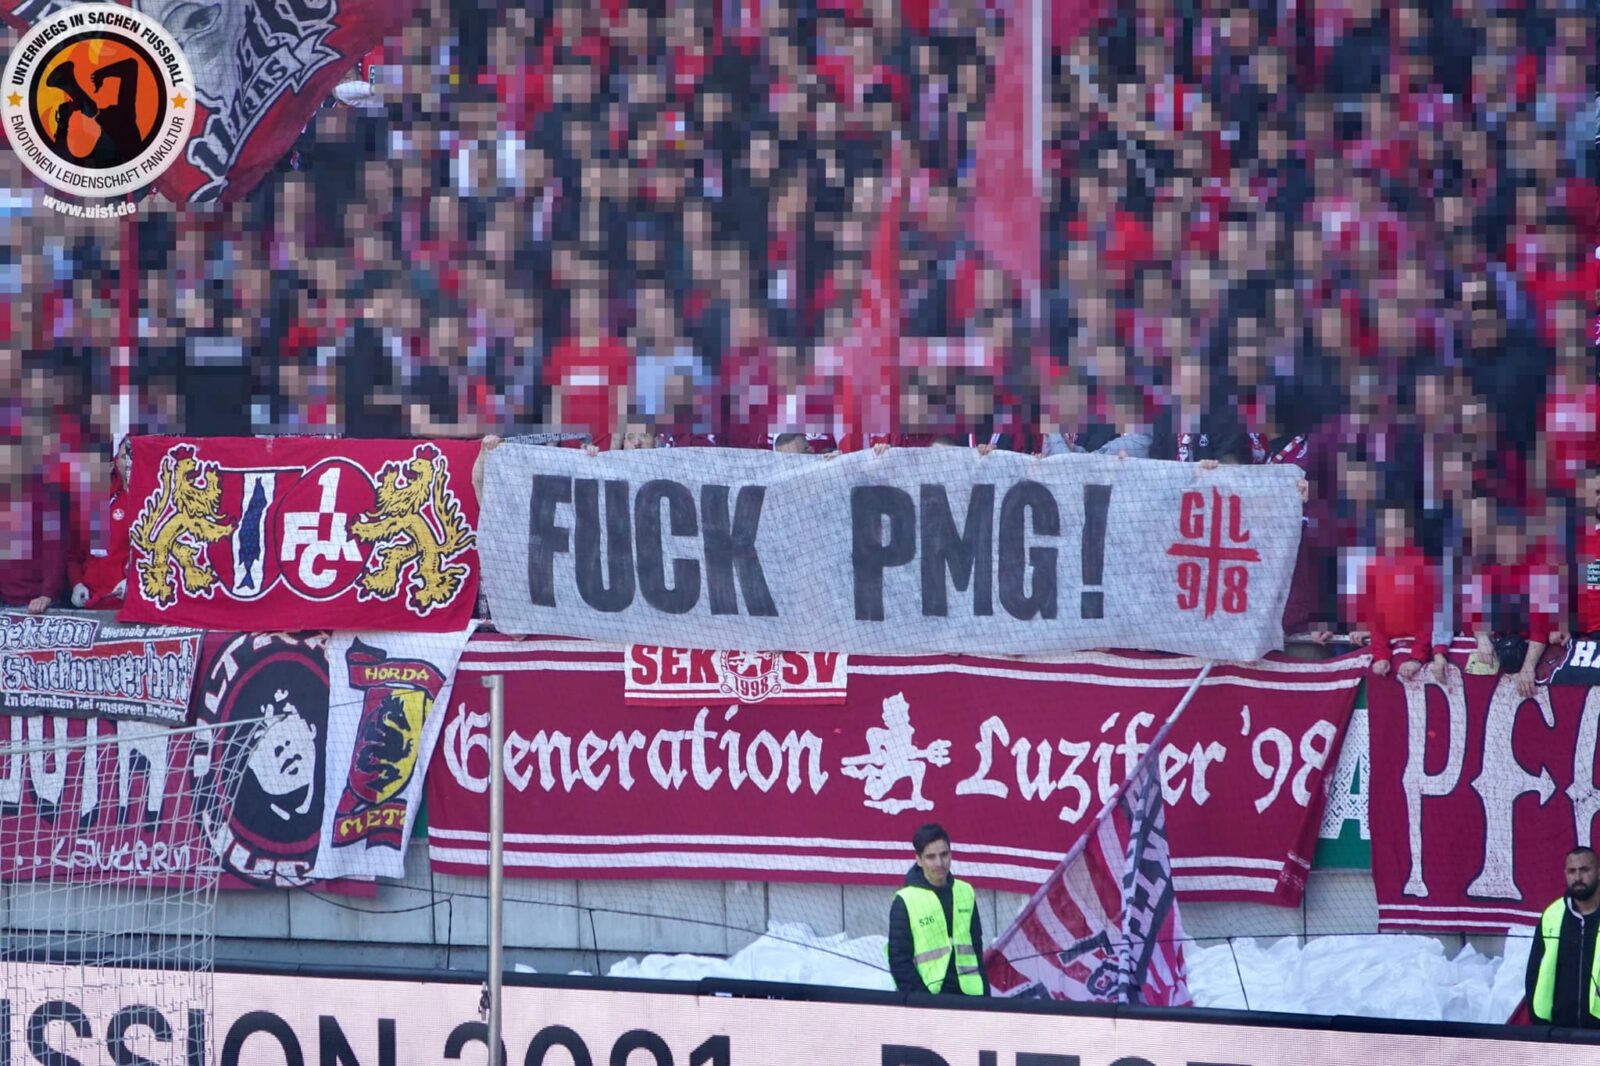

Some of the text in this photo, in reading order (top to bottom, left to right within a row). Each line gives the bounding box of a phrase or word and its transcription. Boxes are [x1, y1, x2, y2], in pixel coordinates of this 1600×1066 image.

[528, 474, 1112, 621] FUCK PMG!
[364, 666, 430, 682] HORDA
[631, 645, 841, 685] SEK SV
[20, 693, 73, 709] Gedanken
[735, 675, 769, 697] 1998
[443, 702, 829, 795] Generation
[956, 711, 1227, 823] Luzifer
